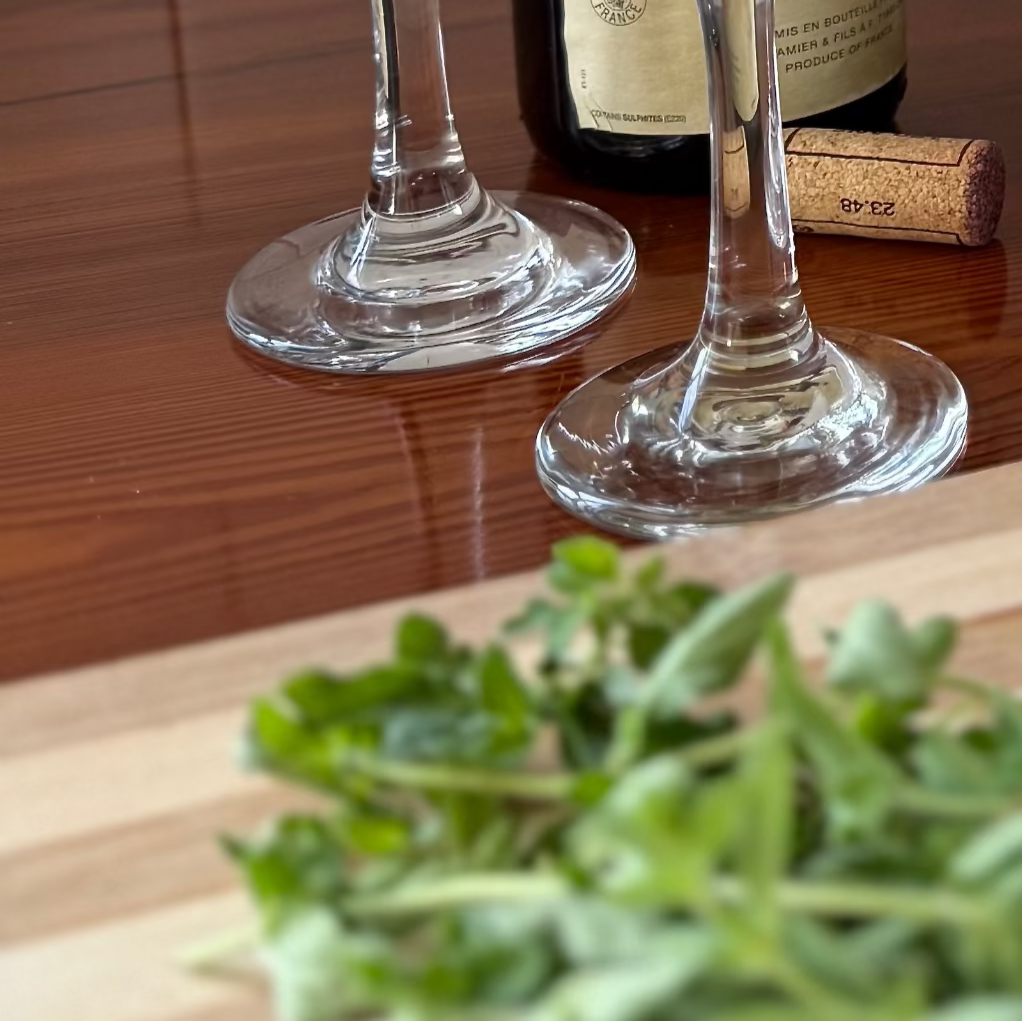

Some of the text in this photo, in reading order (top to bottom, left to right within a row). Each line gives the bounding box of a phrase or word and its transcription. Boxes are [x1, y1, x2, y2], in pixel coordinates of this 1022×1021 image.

[595, 2, 642, 24] FRANCE
[775, 26, 798, 38] MIS
[803, 21, 819, 33] EN
[776, 40, 818, 58] AMIER
[834, 27, 856, 43] FILS
[785, 48, 845, 73] PRODUCE
[848, 42, 861, 55] OF
[840, 198, 895, 216] 23.48
